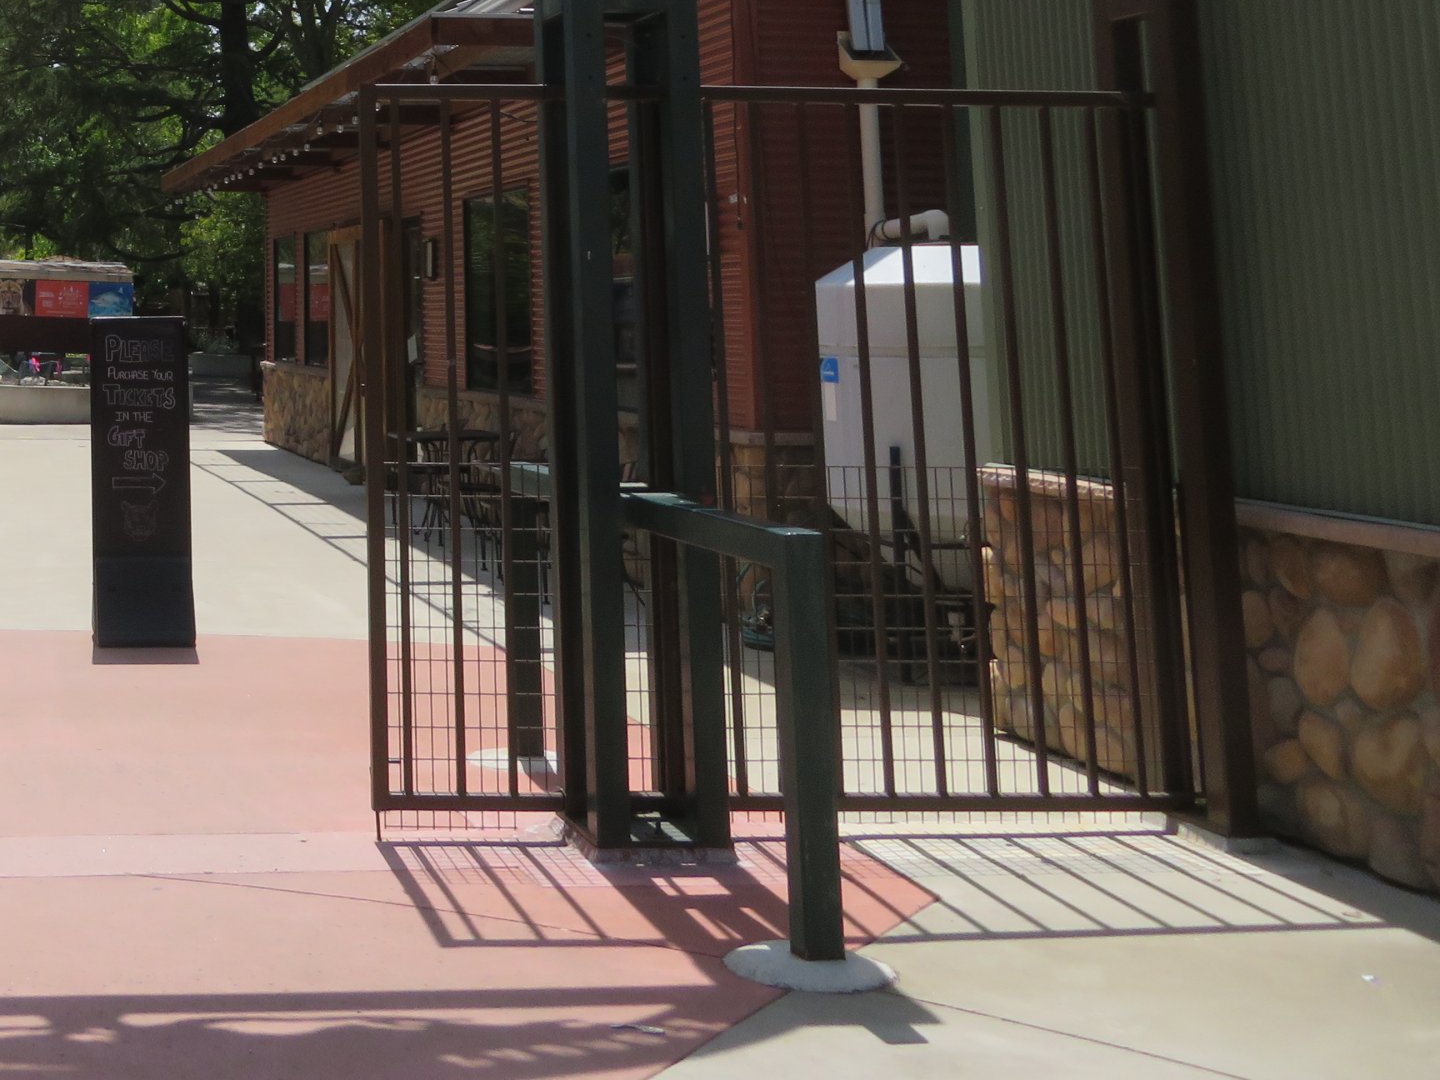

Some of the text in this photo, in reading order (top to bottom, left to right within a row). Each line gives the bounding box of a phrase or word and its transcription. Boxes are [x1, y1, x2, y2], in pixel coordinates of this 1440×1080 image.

[105, 334, 175, 363] PLEASE
[107, 366, 174, 381] PURCHASE YOUR
[103, 383, 176, 410] TICKETS
[115, 411, 153, 423] IN THE
[107, 426, 146, 448] GIFT
[123, 450, 170, 471] SHOP
